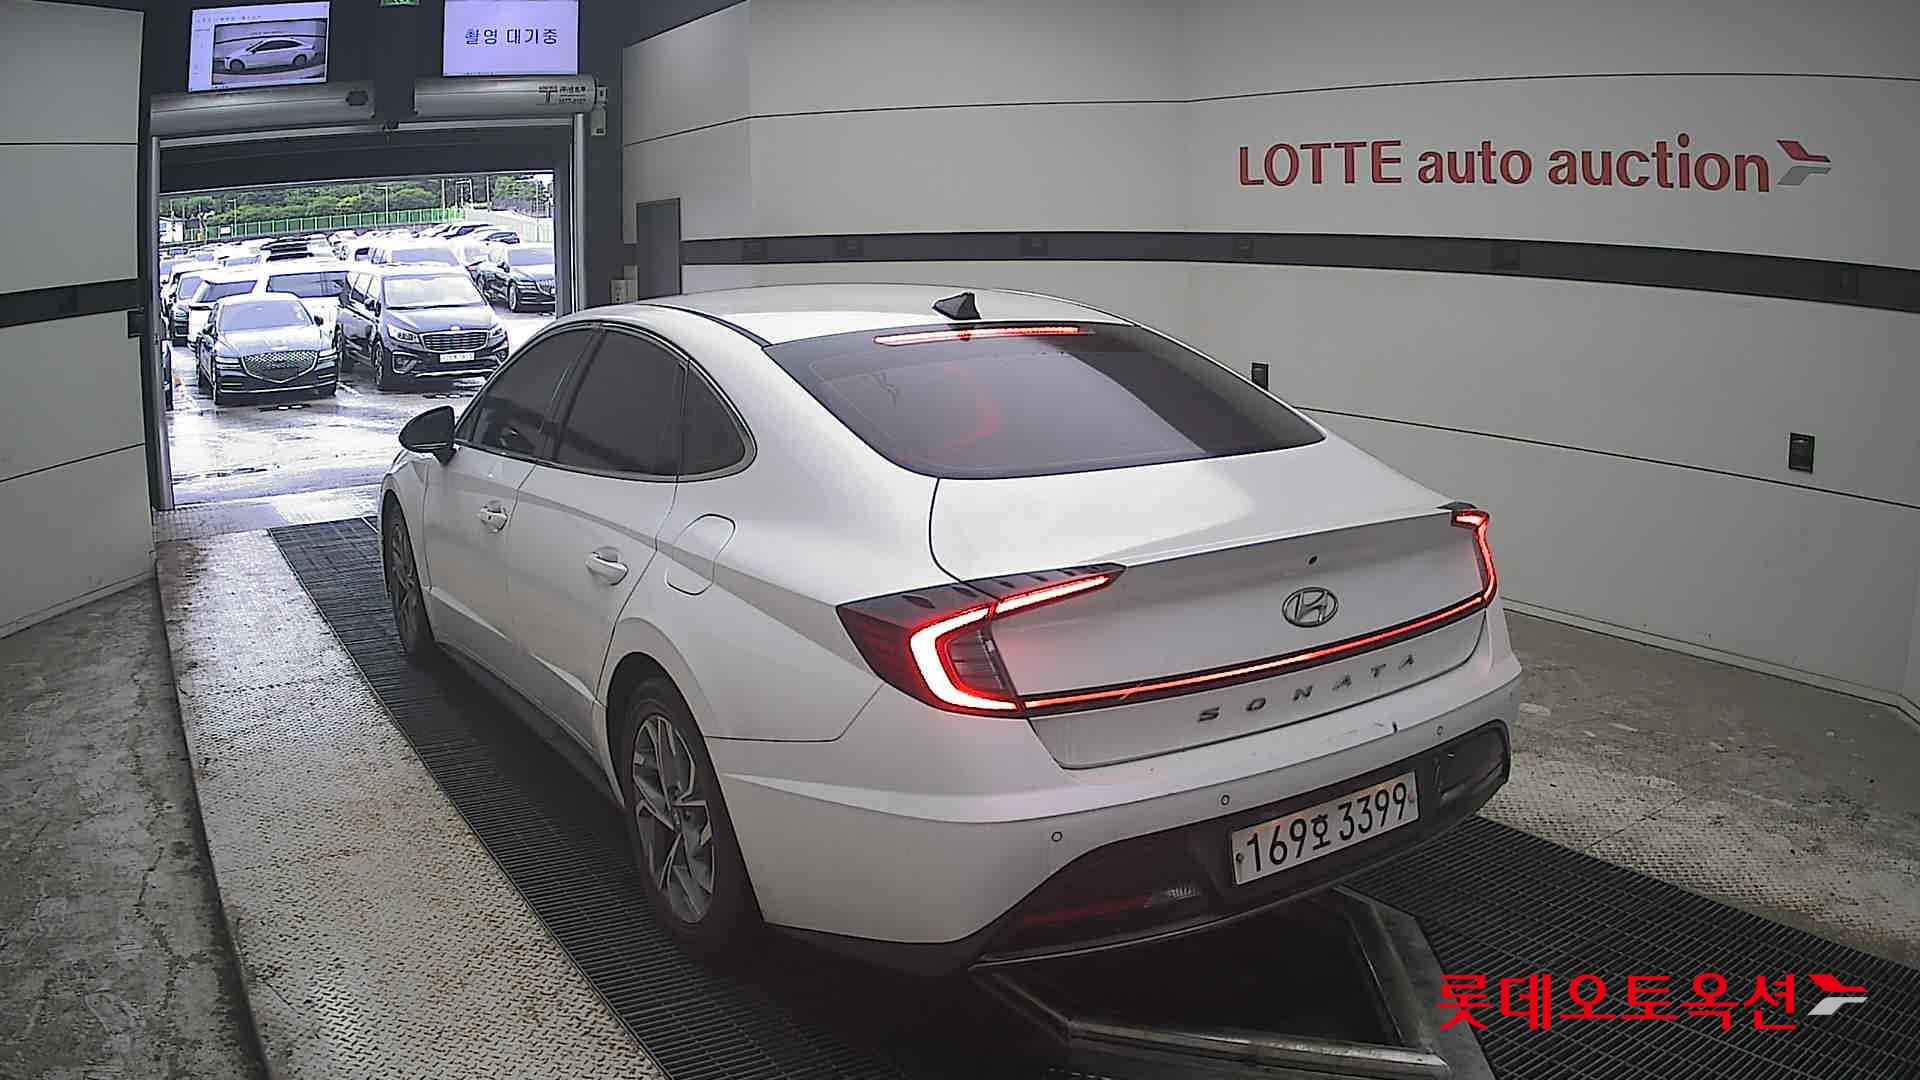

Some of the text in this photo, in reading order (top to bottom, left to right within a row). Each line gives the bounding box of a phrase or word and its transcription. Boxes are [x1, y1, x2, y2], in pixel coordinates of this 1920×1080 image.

[465, 28, 558, 45] 촬영 대기중
[1239, 133, 1770, 192] LOTTE auto auction
[1197, 654, 1415, 722] SONATA
[1247, 781, 1408, 873] 169호 3399
